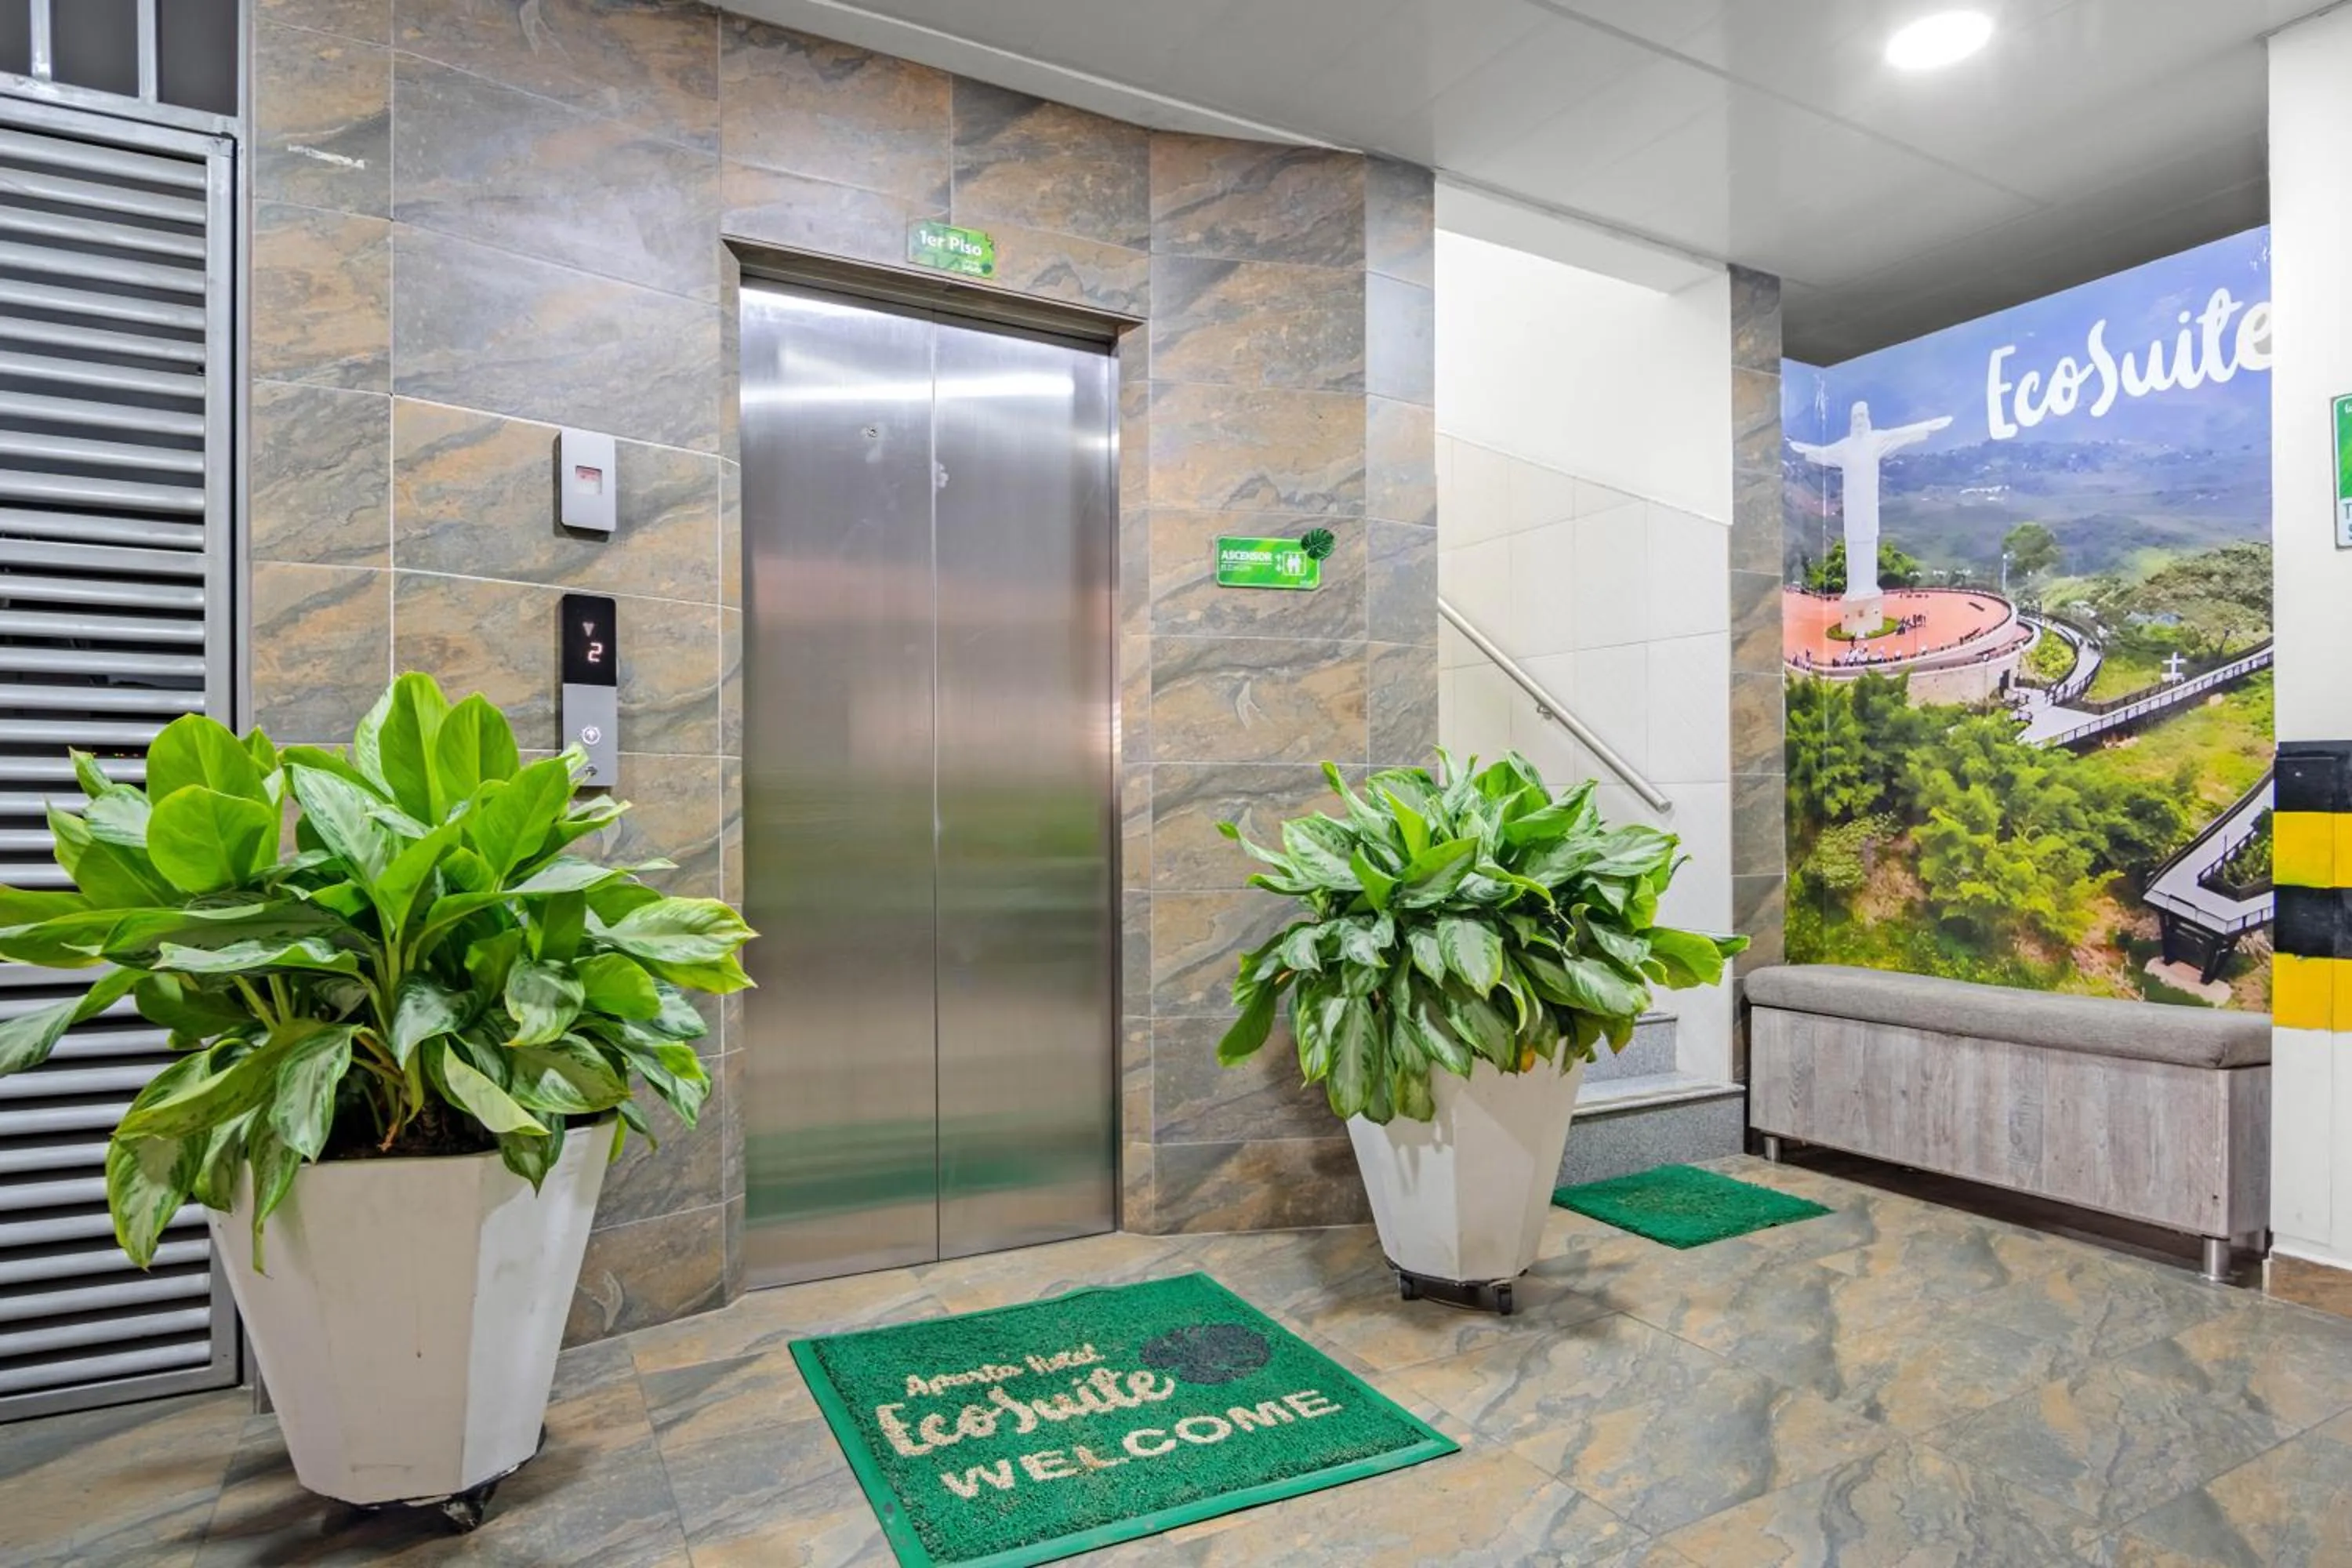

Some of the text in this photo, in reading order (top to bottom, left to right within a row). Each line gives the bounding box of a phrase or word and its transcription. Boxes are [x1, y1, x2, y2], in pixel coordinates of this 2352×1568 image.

[918, 230, 982, 256] 1er Piso
[1987, 288, 2273, 440] EcoSuite
[587, 641, 604, 662] 2
[875, 1367, 1175, 1457] EcoSuite
[941, 1389, 1343, 1499] WELCOME
